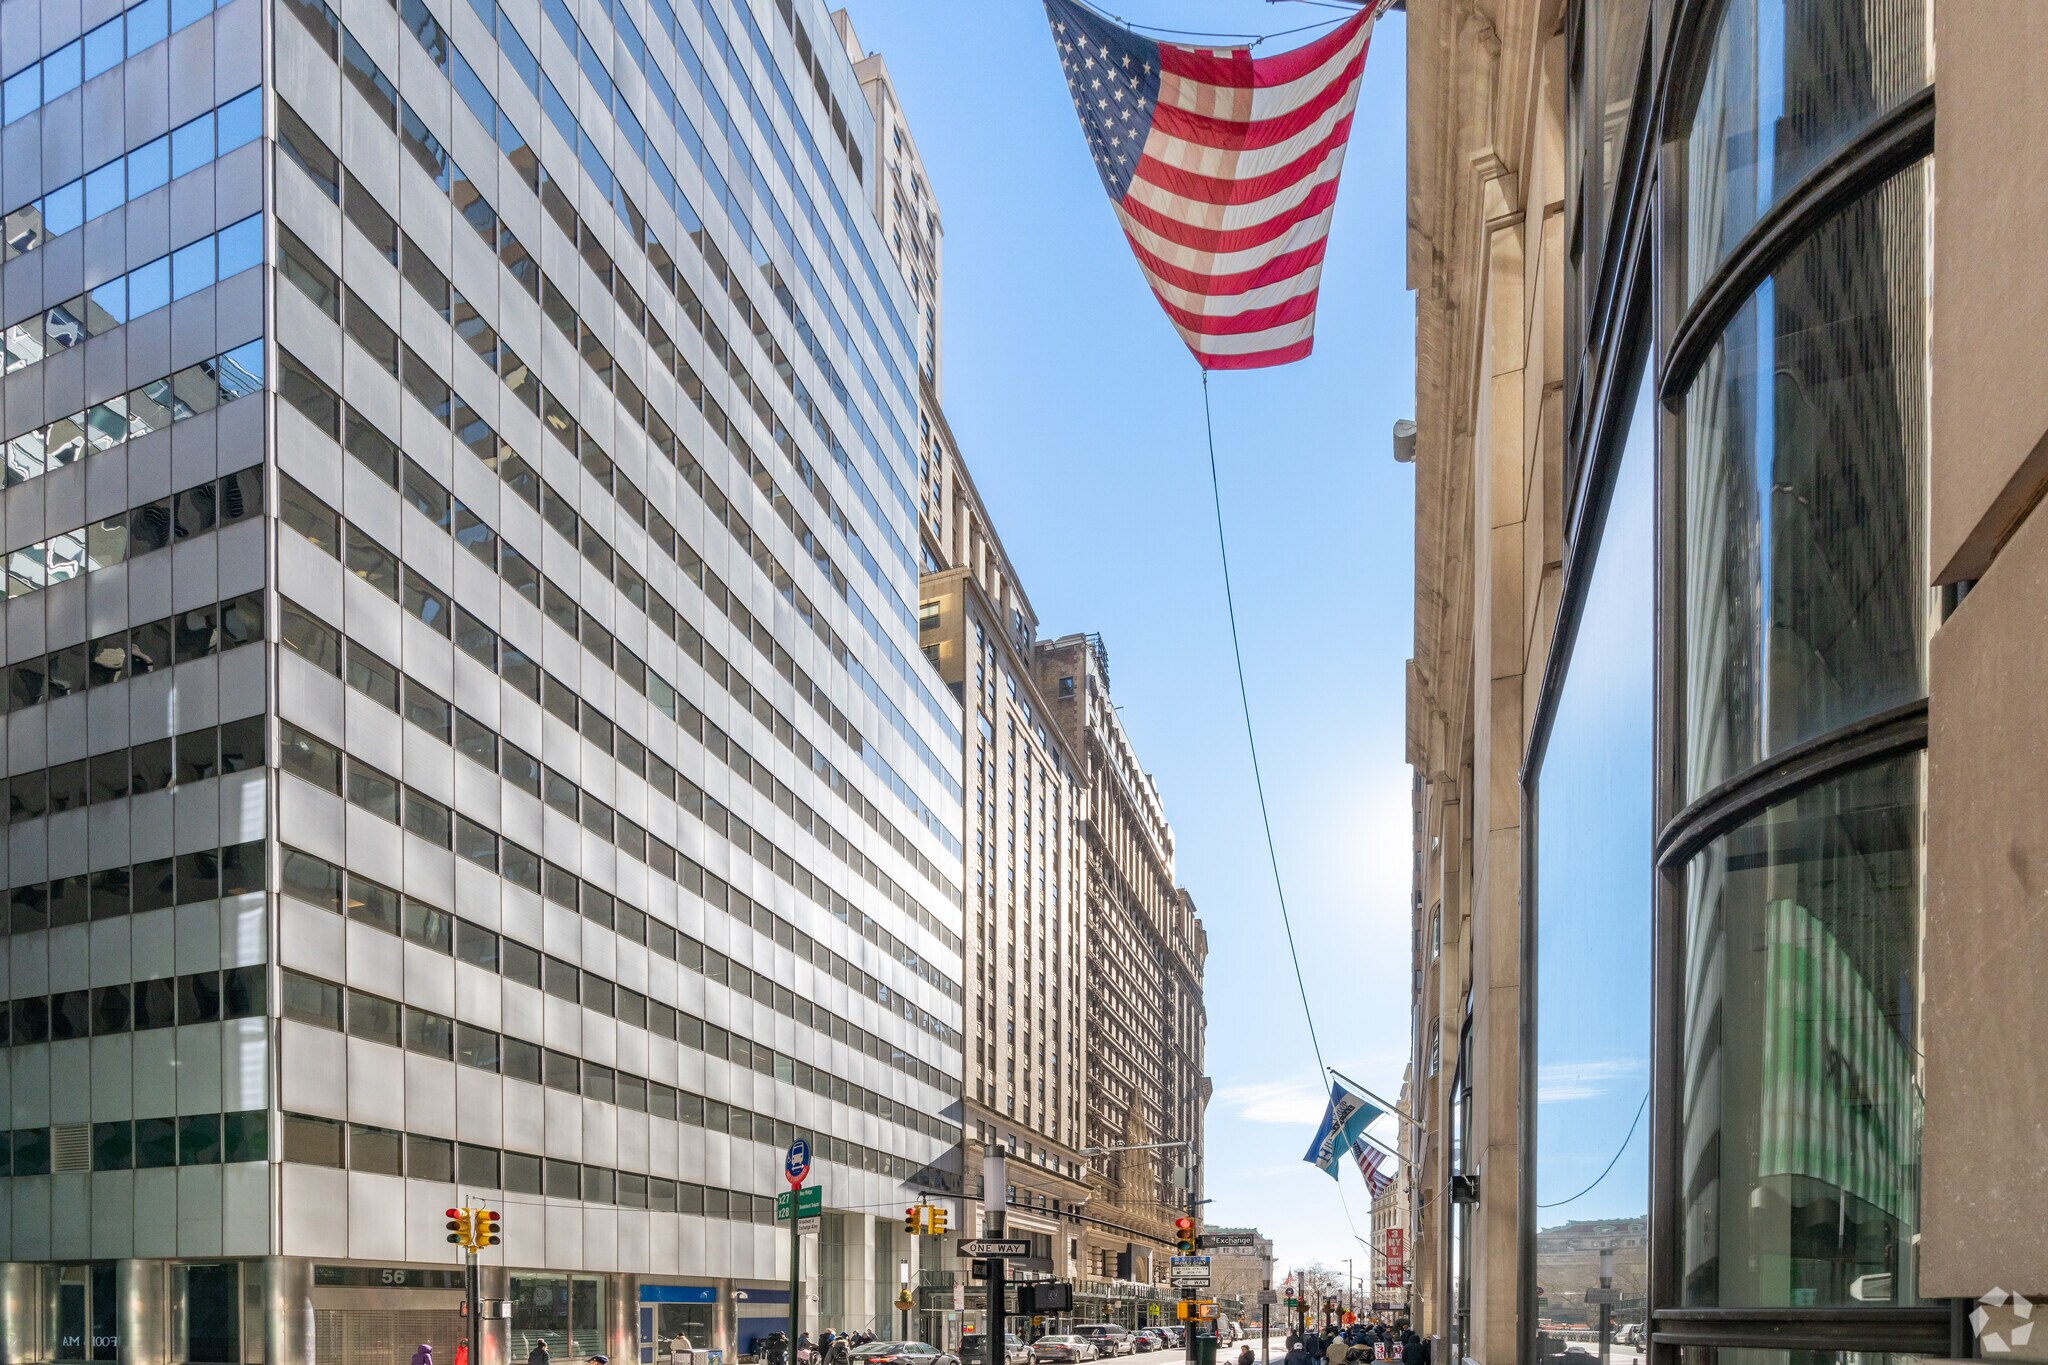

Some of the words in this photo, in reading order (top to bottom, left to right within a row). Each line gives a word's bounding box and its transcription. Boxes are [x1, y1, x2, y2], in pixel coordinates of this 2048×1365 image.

[1391, 1230, 1398, 1238] 3
[1215, 1236, 1251, 1246] Exchange
[1388, 1238, 1401, 1247] NY
[969, 1244, 992, 1252] ONE
[997, 1244, 1020, 1252] WAY
[381, 1269, 405, 1284] 56
